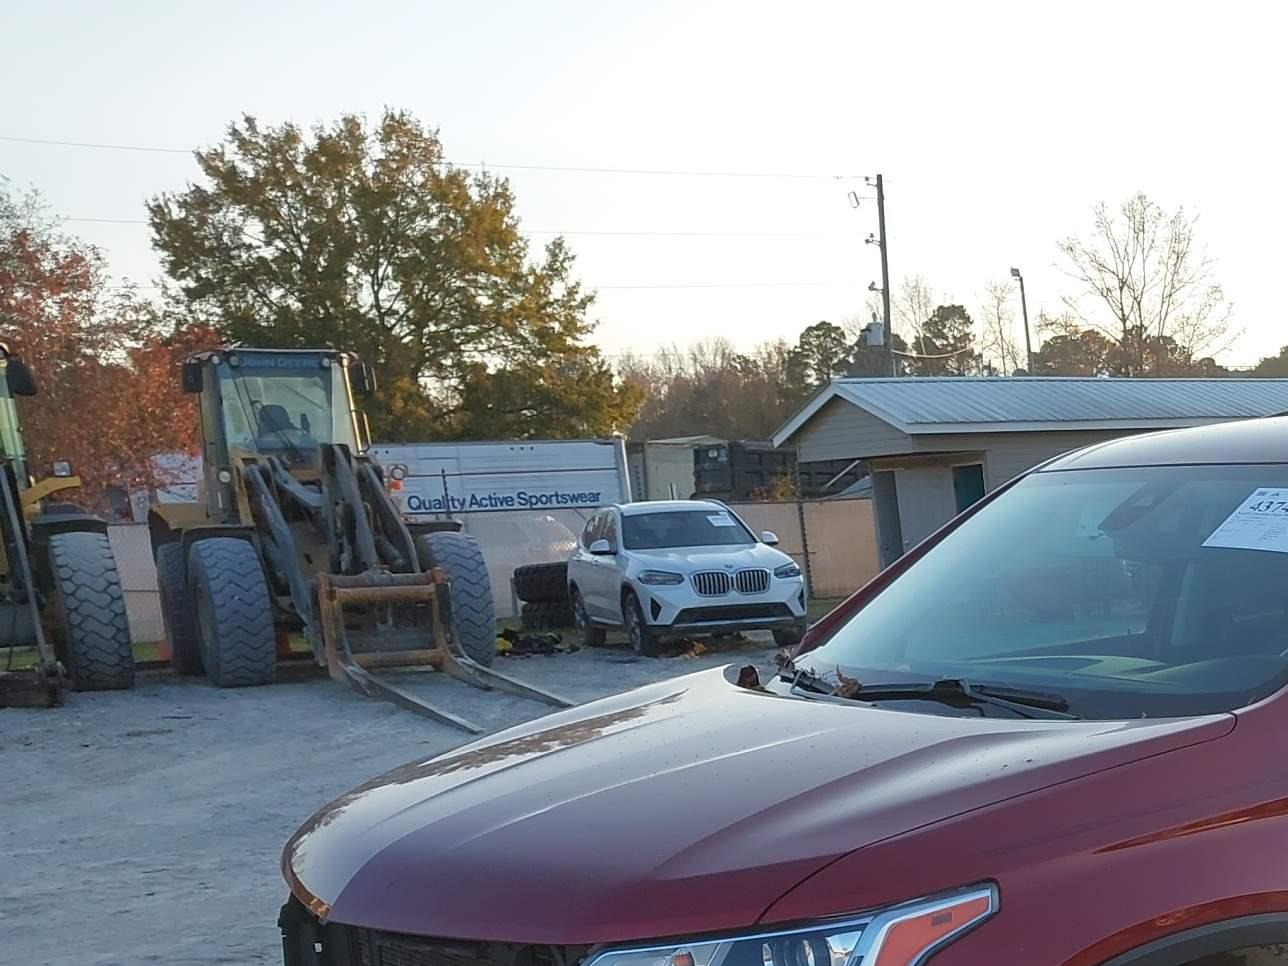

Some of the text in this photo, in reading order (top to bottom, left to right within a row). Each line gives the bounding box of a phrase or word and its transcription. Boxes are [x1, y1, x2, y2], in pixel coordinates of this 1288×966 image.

[407, 490, 601, 512] Quality Active Sportswear
